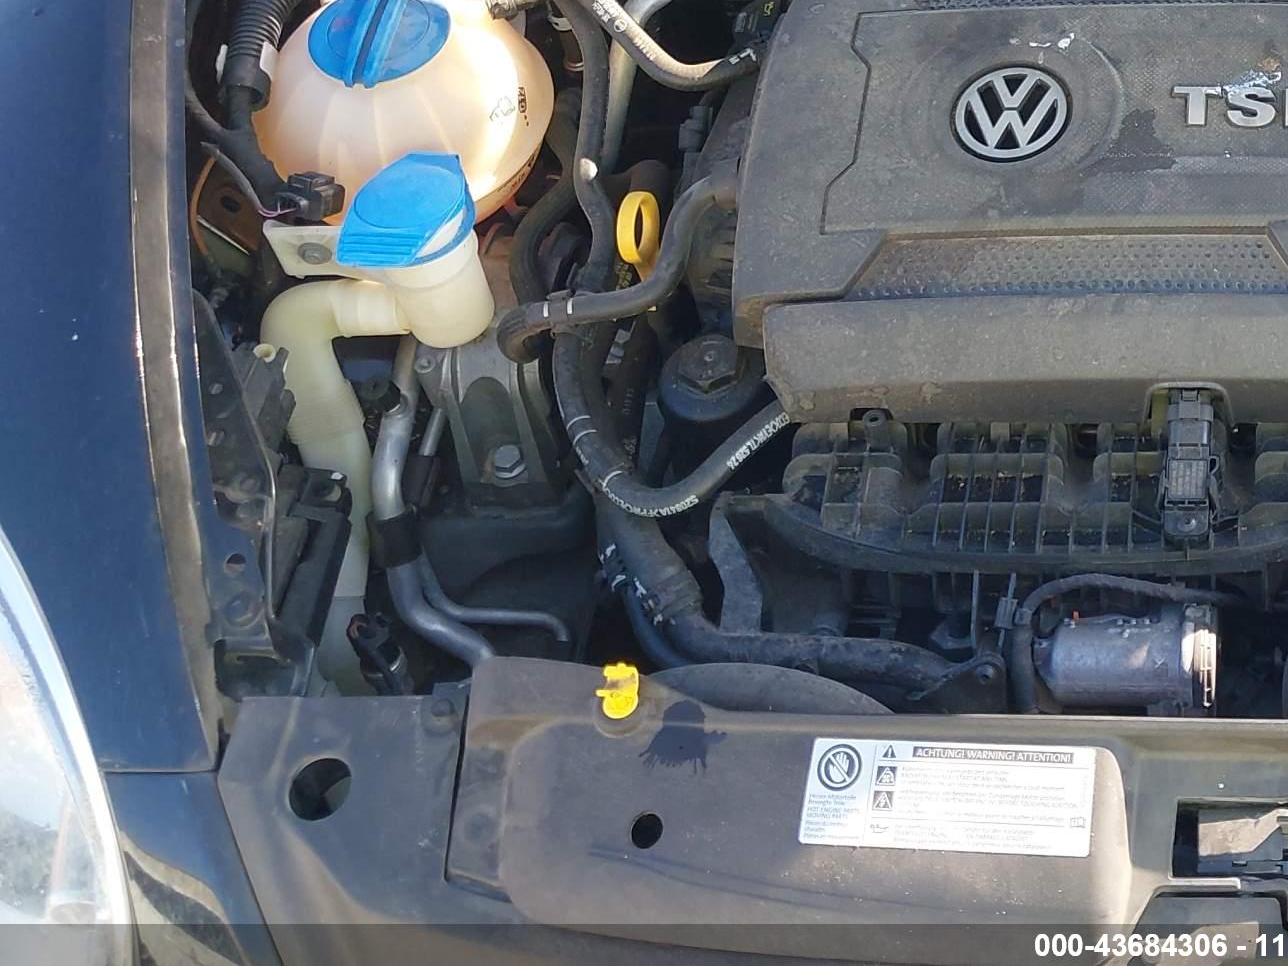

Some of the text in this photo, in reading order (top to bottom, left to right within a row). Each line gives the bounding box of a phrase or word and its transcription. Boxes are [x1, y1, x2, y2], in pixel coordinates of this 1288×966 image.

[916, 748, 1072, 763] ACHTUNG! WARNING! ATTENTION!
